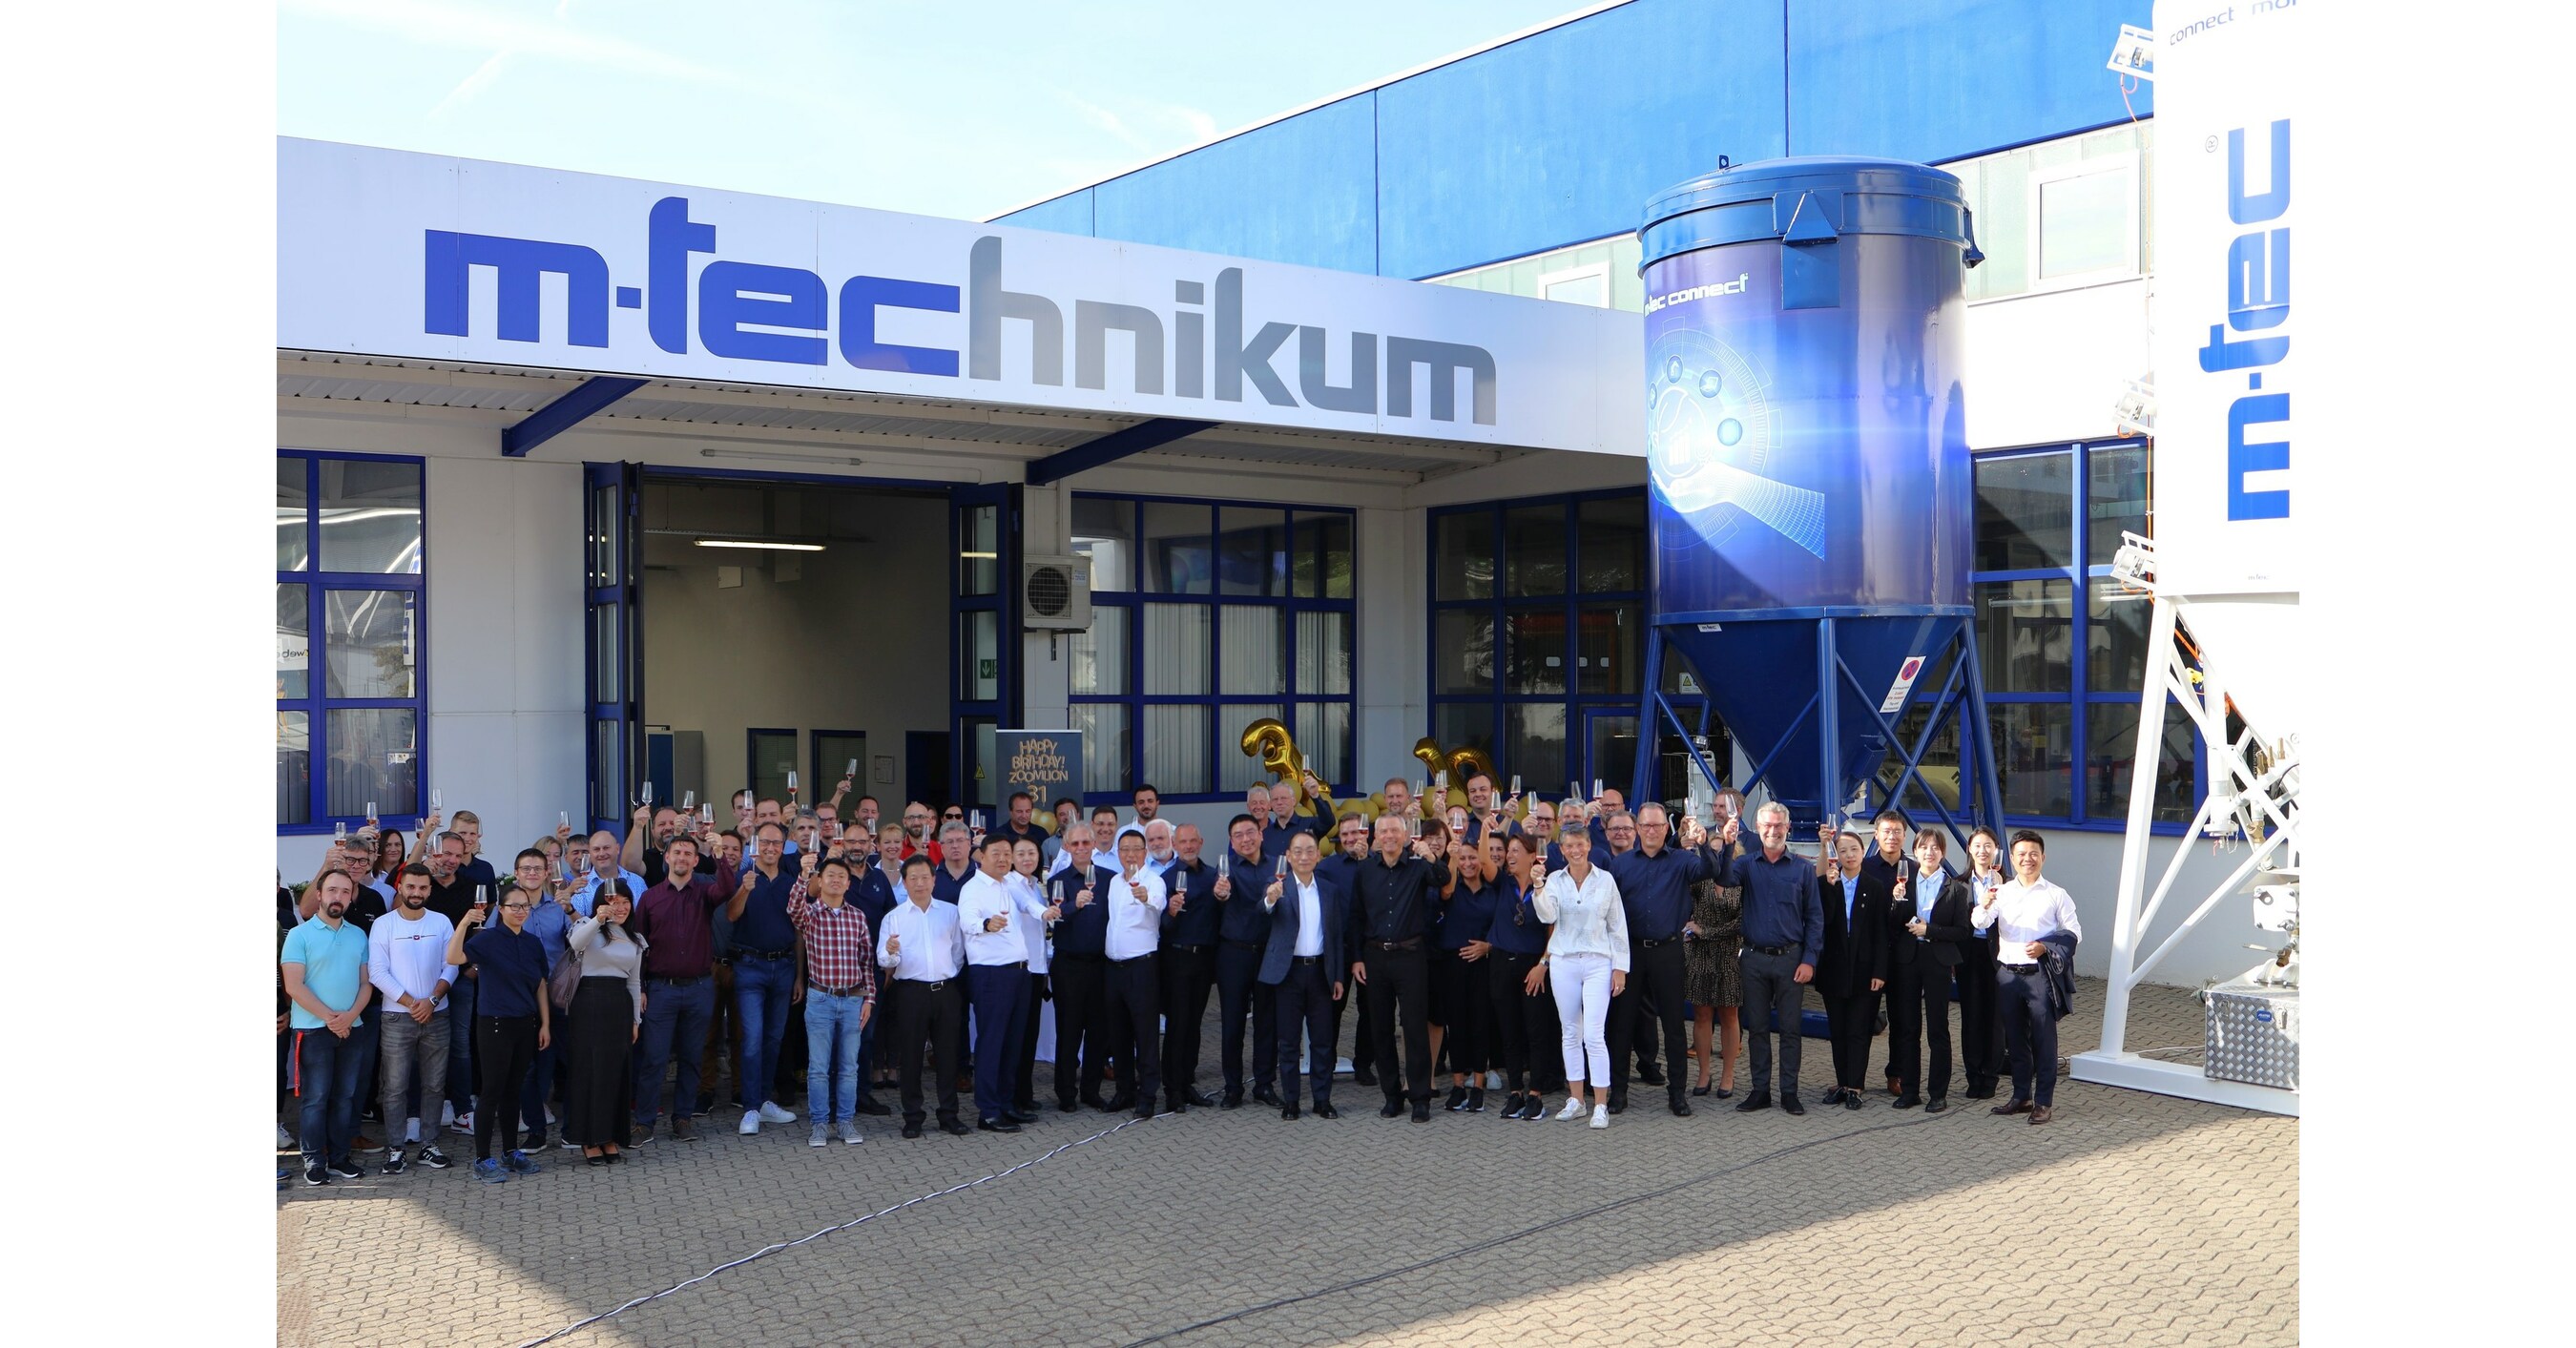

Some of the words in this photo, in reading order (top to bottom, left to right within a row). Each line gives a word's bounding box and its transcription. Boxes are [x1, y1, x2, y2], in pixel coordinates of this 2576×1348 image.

[2170, 7, 2233, 46] connect
[1668, 273, 1749, 306] connect
[1019, 738, 1057, 756] HAPPY
[1011, 753, 1066, 770] BIRTHDAY!
[1008, 769, 1069, 784] ZOOMLION
[1027, 784, 1047, 804] 31
